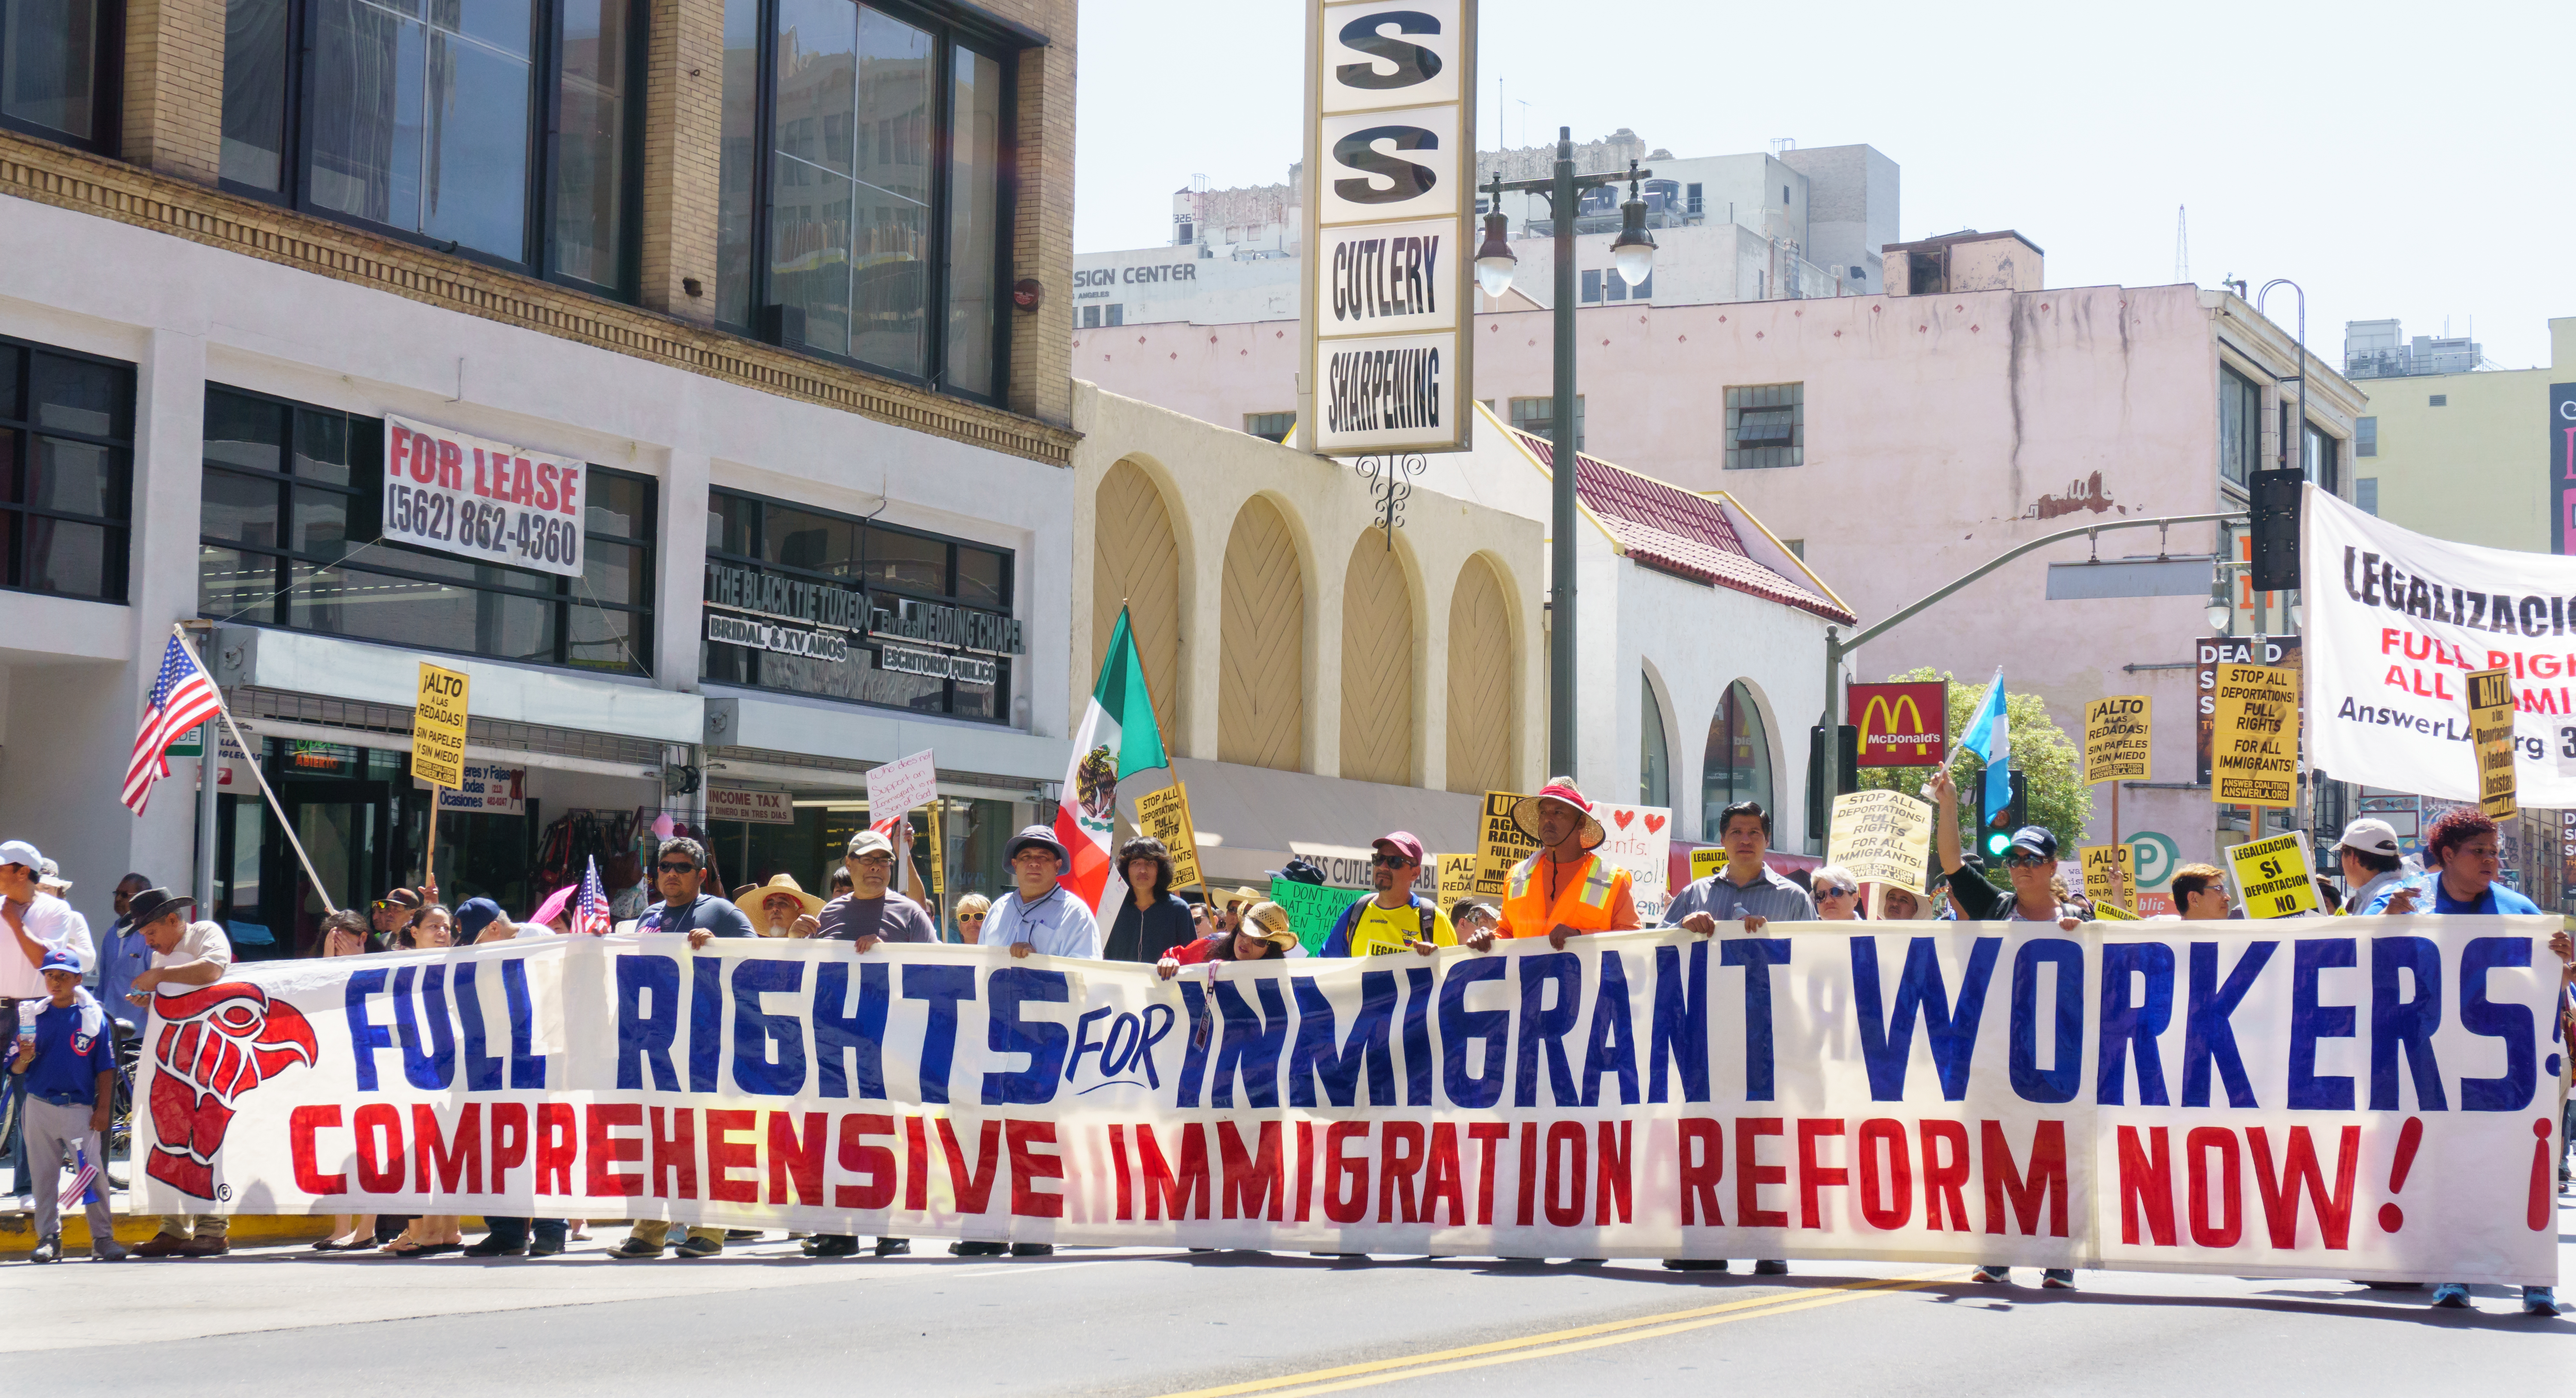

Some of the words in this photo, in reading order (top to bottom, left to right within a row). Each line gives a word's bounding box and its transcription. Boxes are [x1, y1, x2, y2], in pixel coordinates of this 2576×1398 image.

[1074, 269, 1115, 287] SIGN
[1123, 263, 1196, 283] CENTER
[1333, 235, 1439, 322] CUTLERY
[1329, 346, 1440, 434] SHARPENING
[390, 426, 462, 491] FOR
[474, 447, 578, 516] LEASE
[389, 483, 454, 541] (562)
[459, 500, 576, 566] 862-4360
[711, 563, 740, 607] THE
[743, 570, 790, 615] BLACK
[793, 581, 815, 620] TIE
[818, 586, 873, 630] TUXEDO
[917, 603, 975, 646] WEDDING
[978, 614, 1026, 654] CHAPEL
[711, 618, 765, 645] BRIDAL
[771, 628, 781, 647] &
[784, 631, 806, 651] XV
[808, 632, 846, 659] AÑOS
[2382, 628, 2475, 670] FULL
[884, 647, 949, 675] ESCRITORIO
[952, 659, 996, 683] PUBLICO
[423, 672, 462, 697] ¡ALTO
[2230, 669, 2264, 683] STOP
[2266, 672, 2287, 686] ALL
[2384, 665, 2454, 701] ALL
[2221, 687, 2294, 703] DEPORTATIONS!
[2479, 674, 2512, 707] ALTO
[436, 697, 448, 707] LAS
[2244, 703, 2275, 717] FULL
[419, 703, 463, 727] REDADAS!
[2092, 699, 2143, 723] ¡ALTO
[2492, 712, 2496, 722] a
[2089, 724, 2148, 741] REDADAS!
[2236, 717, 2281, 732] RIGHTS
[416, 727, 426, 739] SIN
[428, 730, 462, 748] PAPELES
[1868, 733, 1940, 744] McDonald's
[416, 742, 421, 752] Y
[422, 745, 432, 757] SIN
[434, 748, 459, 764] MIEDO
[2088, 744, 2102, 755] SIN
[2105, 740, 2148, 751] PAPELES
[2234, 739, 2257, 752] FOR
[2260, 741, 2281, 754] ALL
[295, 754, 338, 769] ABIERTO
[417, 759, 432, 769] ANSWER
[433, 763, 455, 774] COALITION
[870, 766, 894, 779] Who
[898, 758, 917, 769] does
[919, 751, 932, 762] not
[2090, 757, 2096, 766] Y
[2096, 753, 2111, 764] SIN
[2114, 751, 2146, 760] MIEDO
[2220, 755, 2294, 772] IMMIGRANTS!
[417, 767, 455, 783] ANSWERLA.ORG
[490, 765, 510, 782] Fajas
[2091, 765, 2112, 774] ANSWER
[2091, 769, 2142, 780] ANSWERLA.ORG
[872, 774, 910, 797] Support
[913, 770, 925, 779] an
[927, 777, 936, 787] not
[2224, 779, 2253, 787] ANSWER
[2254, 781, 2287, 790] COALITION
[2486, 774, 2512, 795] Racistas
[440, 791, 483, 807] Ocasiones
[709, 790, 750, 805] INCOME
[756, 794, 780, 808] TAX
[886, 804, 901, 814] son
[904, 794, 914, 806] of
[916, 788, 931, 800] God
[1143, 795, 1160, 809] STOP
[1162, 789, 1177, 802] ALL
[1849, 793, 1886, 805] STOP
[1889, 795, 1916, 810] ALL
[2223, 787, 2287, 799] ANSWERLA.ORG
[715, 807, 738, 818] DINERO
[752, 810, 768, 818] TRES
[771, 811, 787, 820] DIAS
[1838, 805, 1925, 824] DEPORTATIONS!
[1862, 814, 1899, 825] FULL
[1154, 815, 1173, 830] FULL
[1853, 824, 1906, 837] RIGHTS
[1153, 824, 1179, 839] RIGHTS
[1169, 840, 1183, 853] ALL
[1491, 846, 1511, 858] FULL
[1851, 837, 1877, 848] FOR
[1880, 839, 1906, 851] ALL
[2233, 836, 2298, 861] LEGALIZACION
[1835, 849, 1922, 868] IMMIGRANTS!
[2088, 849, 2126, 868] ¡ALO
[2135, 844, 2157, 875] P
[1333, 858, 1375, 885] CUTLE
[1873, 863, 1913, 878] COALITION
[2260, 856, 2283, 879] SÍ
[1272, 882, 1283, 896] I
[1293, 884, 1329, 901] DONT
[2088, 889, 2101, 897] SIN
[2244, 874, 2309, 898] DEPORTACION
[1305, 902, 1321, 918] IS
[2139, 898, 2165, 910] blic
[2275, 894, 2297, 913] NO
[1311, 933, 1325, 945] OR
[345, 958, 546, 1092] FULL
[616, 955, 1071, 1106] RIGHTS
[1064, 1003, 1175, 1095] FOR
[1177, 938, 1791, 1108] INMIGRANT
[290, 1103, 1063, 1218] COMPREHENSIVE
[1108, 1120, 1632, 1227] IMMIGRATION
[1678, 1118, 2069, 1237] REFORM
[2117, 1116, 2423, 1250] NOW!
